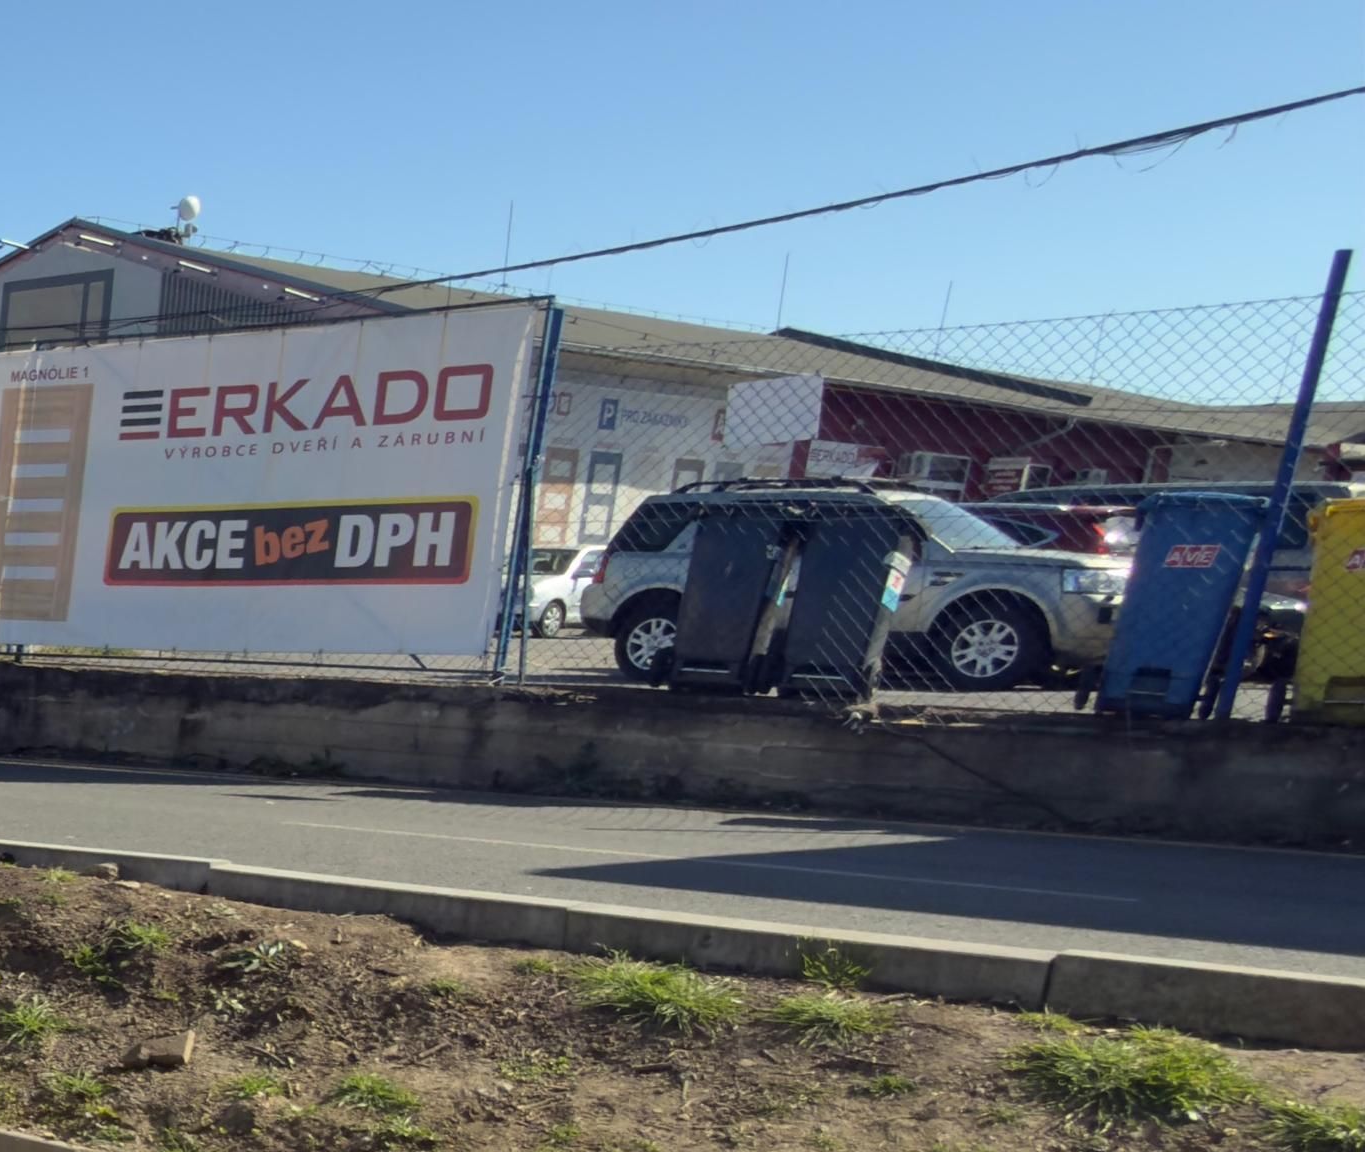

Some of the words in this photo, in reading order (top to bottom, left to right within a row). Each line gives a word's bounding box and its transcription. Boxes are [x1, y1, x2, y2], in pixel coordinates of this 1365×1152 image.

[10, 365, 78, 383] MAGNÓLIE
[167, 364, 495, 439] ERKADO
[164, 440, 258, 460] VÝROBCE
[271, 436, 339, 455] DVEŘÍ
[350, 437, 362, 449] A
[377, 427, 486, 448] ZÁRUBNÍ
[118, 519, 249, 570] AKCE
[253, 519, 330, 566] bez
[334, 511, 457, 568] DPH
[1167, 547, 1214, 563] AVE
[1347, 554, 1365, 569] A
